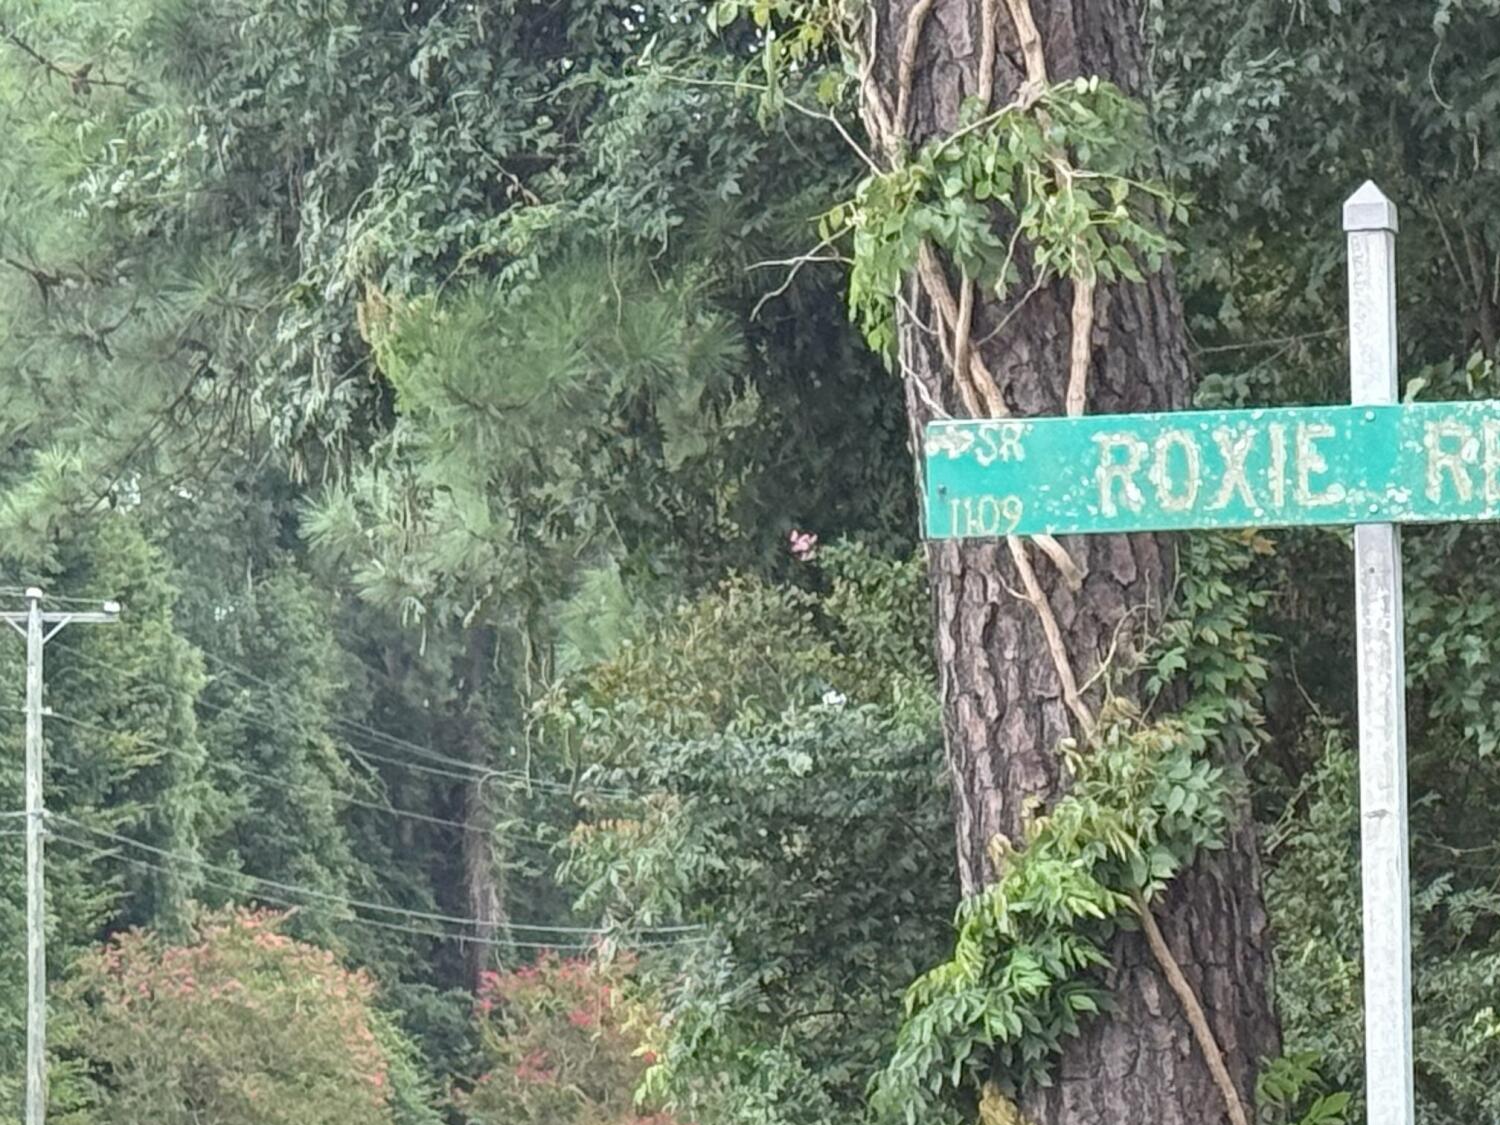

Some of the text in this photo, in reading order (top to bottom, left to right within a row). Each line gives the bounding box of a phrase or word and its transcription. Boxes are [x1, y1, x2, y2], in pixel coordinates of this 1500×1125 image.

[975, 423, 1026, 466] SR
[1094, 421, 1336, 517] ROXIE
[951, 495, 1023, 537] 1109
